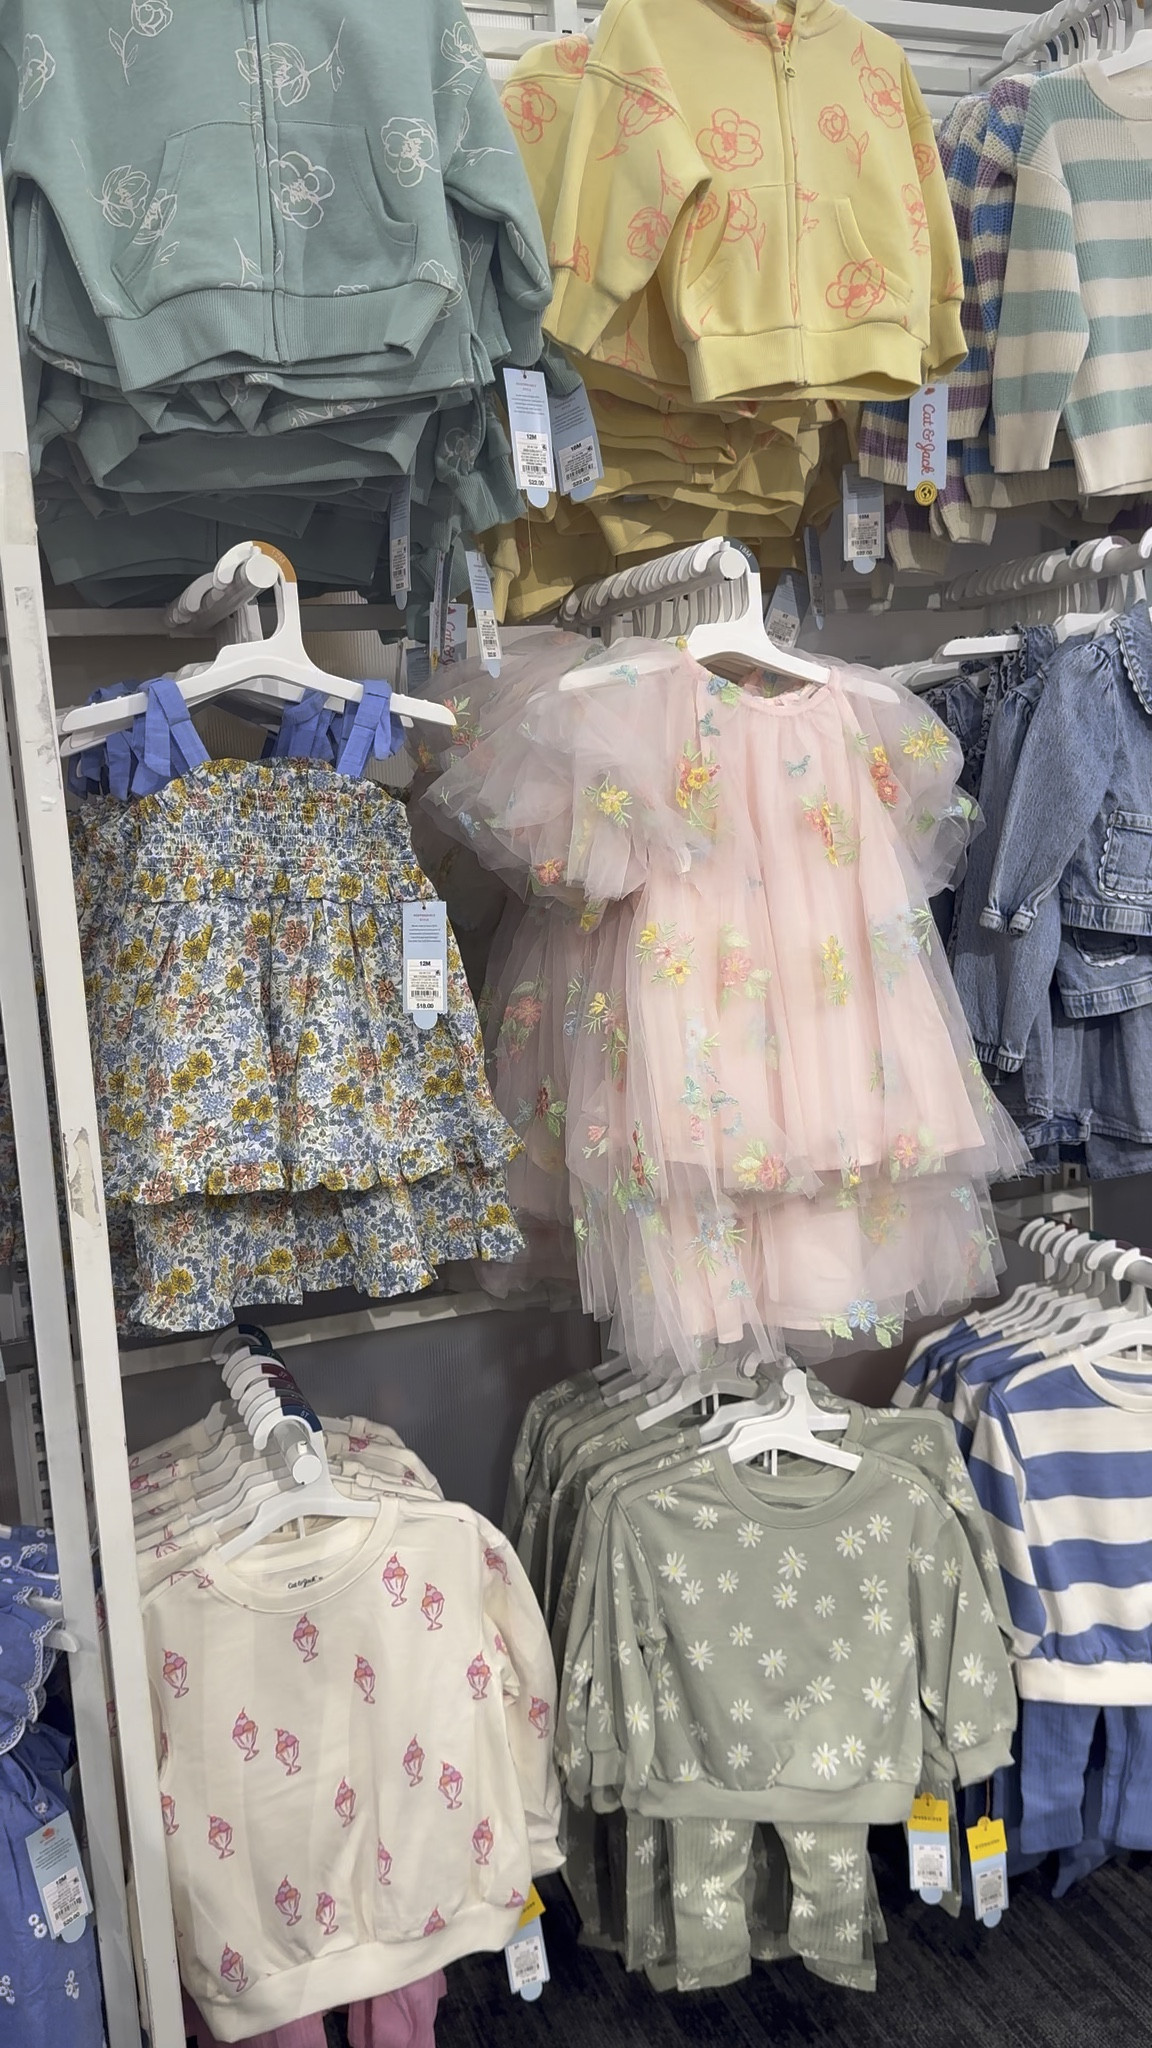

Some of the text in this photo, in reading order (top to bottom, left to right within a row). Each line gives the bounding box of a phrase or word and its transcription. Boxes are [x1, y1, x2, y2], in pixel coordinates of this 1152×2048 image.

[915, 403, 936, 476] Cat & Jack
[572, 476, 590, 488] $22.00
